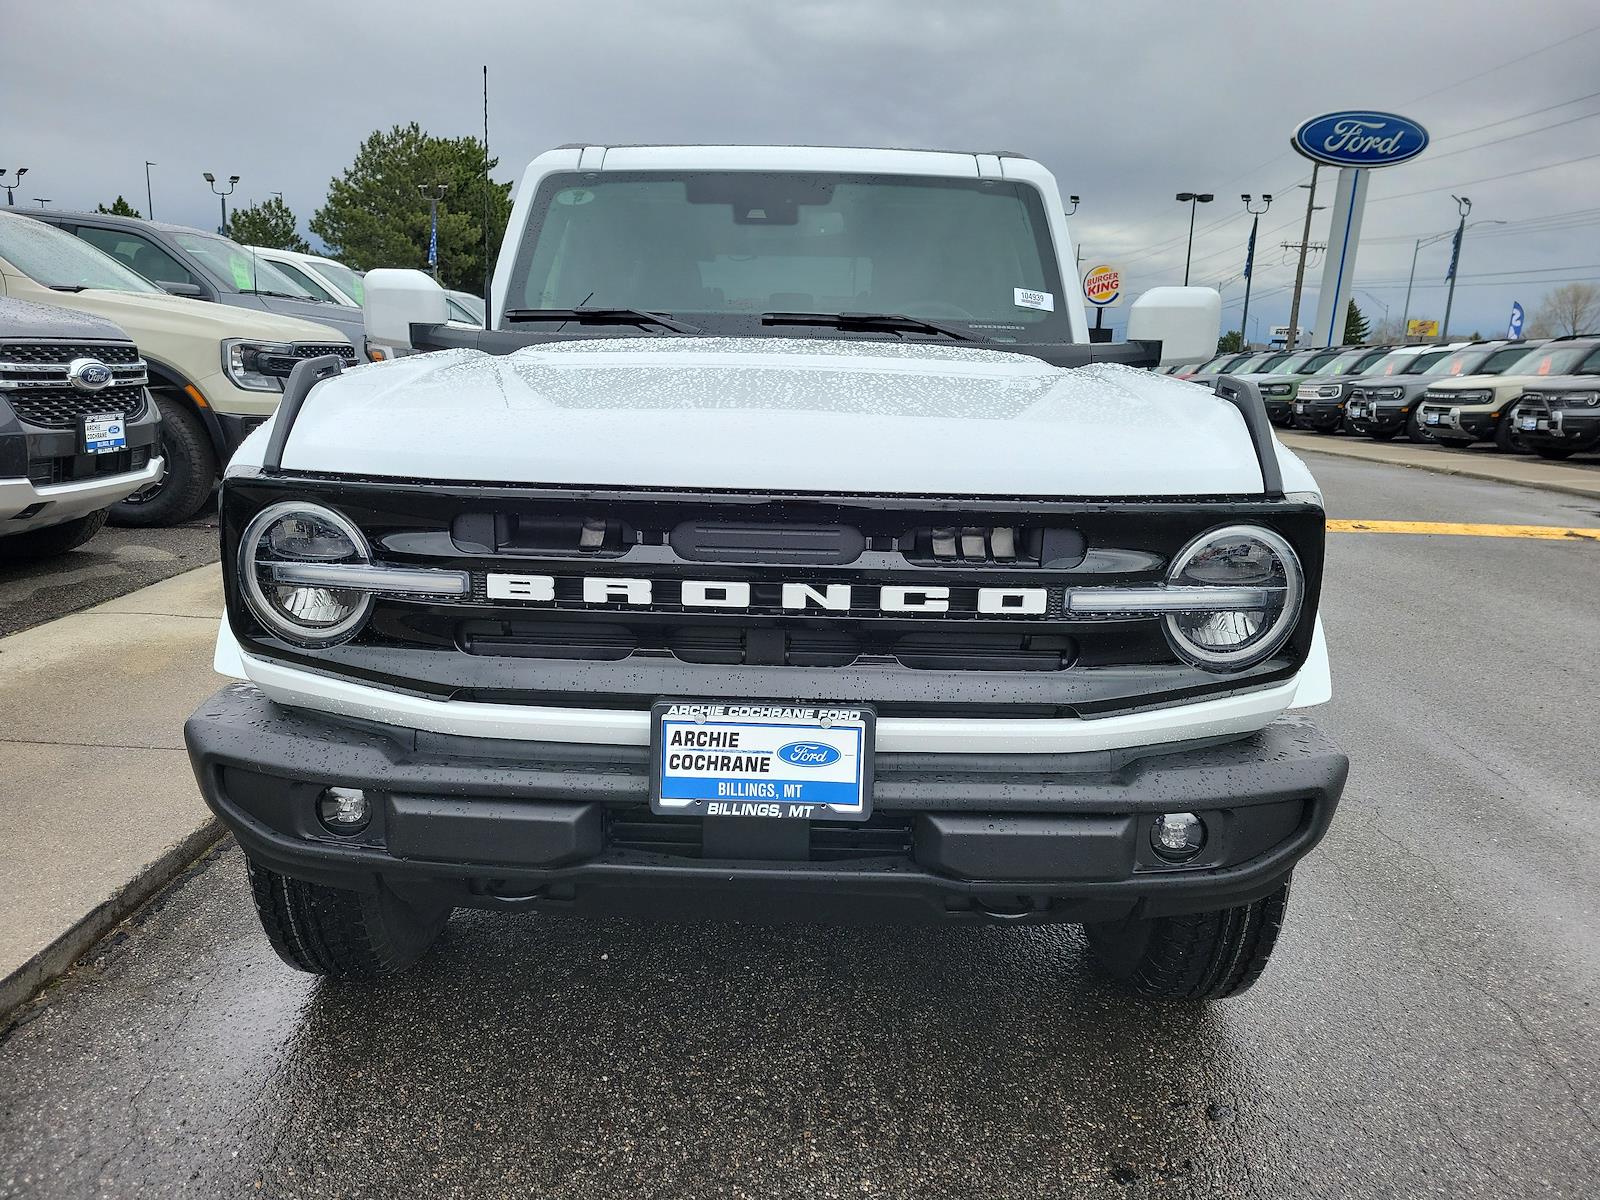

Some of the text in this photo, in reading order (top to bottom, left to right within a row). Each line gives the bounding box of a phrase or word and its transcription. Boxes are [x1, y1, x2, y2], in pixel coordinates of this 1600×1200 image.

[1324, 120, 1404, 154] Ford
[1087, 272, 1118, 286] BURGER
[1088, 280, 1119, 296] KING
[1021, 292, 1044, 302] 104939
[88, 369, 106, 381] Ford
[486, 573, 1048, 615] BRONCO
[667, 705, 861, 721] ARCHIE COCHRANE FORD
[670, 730, 740, 748] ARCHIE
[790, 745, 828, 762] Ford
[669, 754, 771, 773] COCHRANE
[717, 782, 803, 800] BILLINGS, MT
[707, 803, 815, 819] BILLINGS, MT
